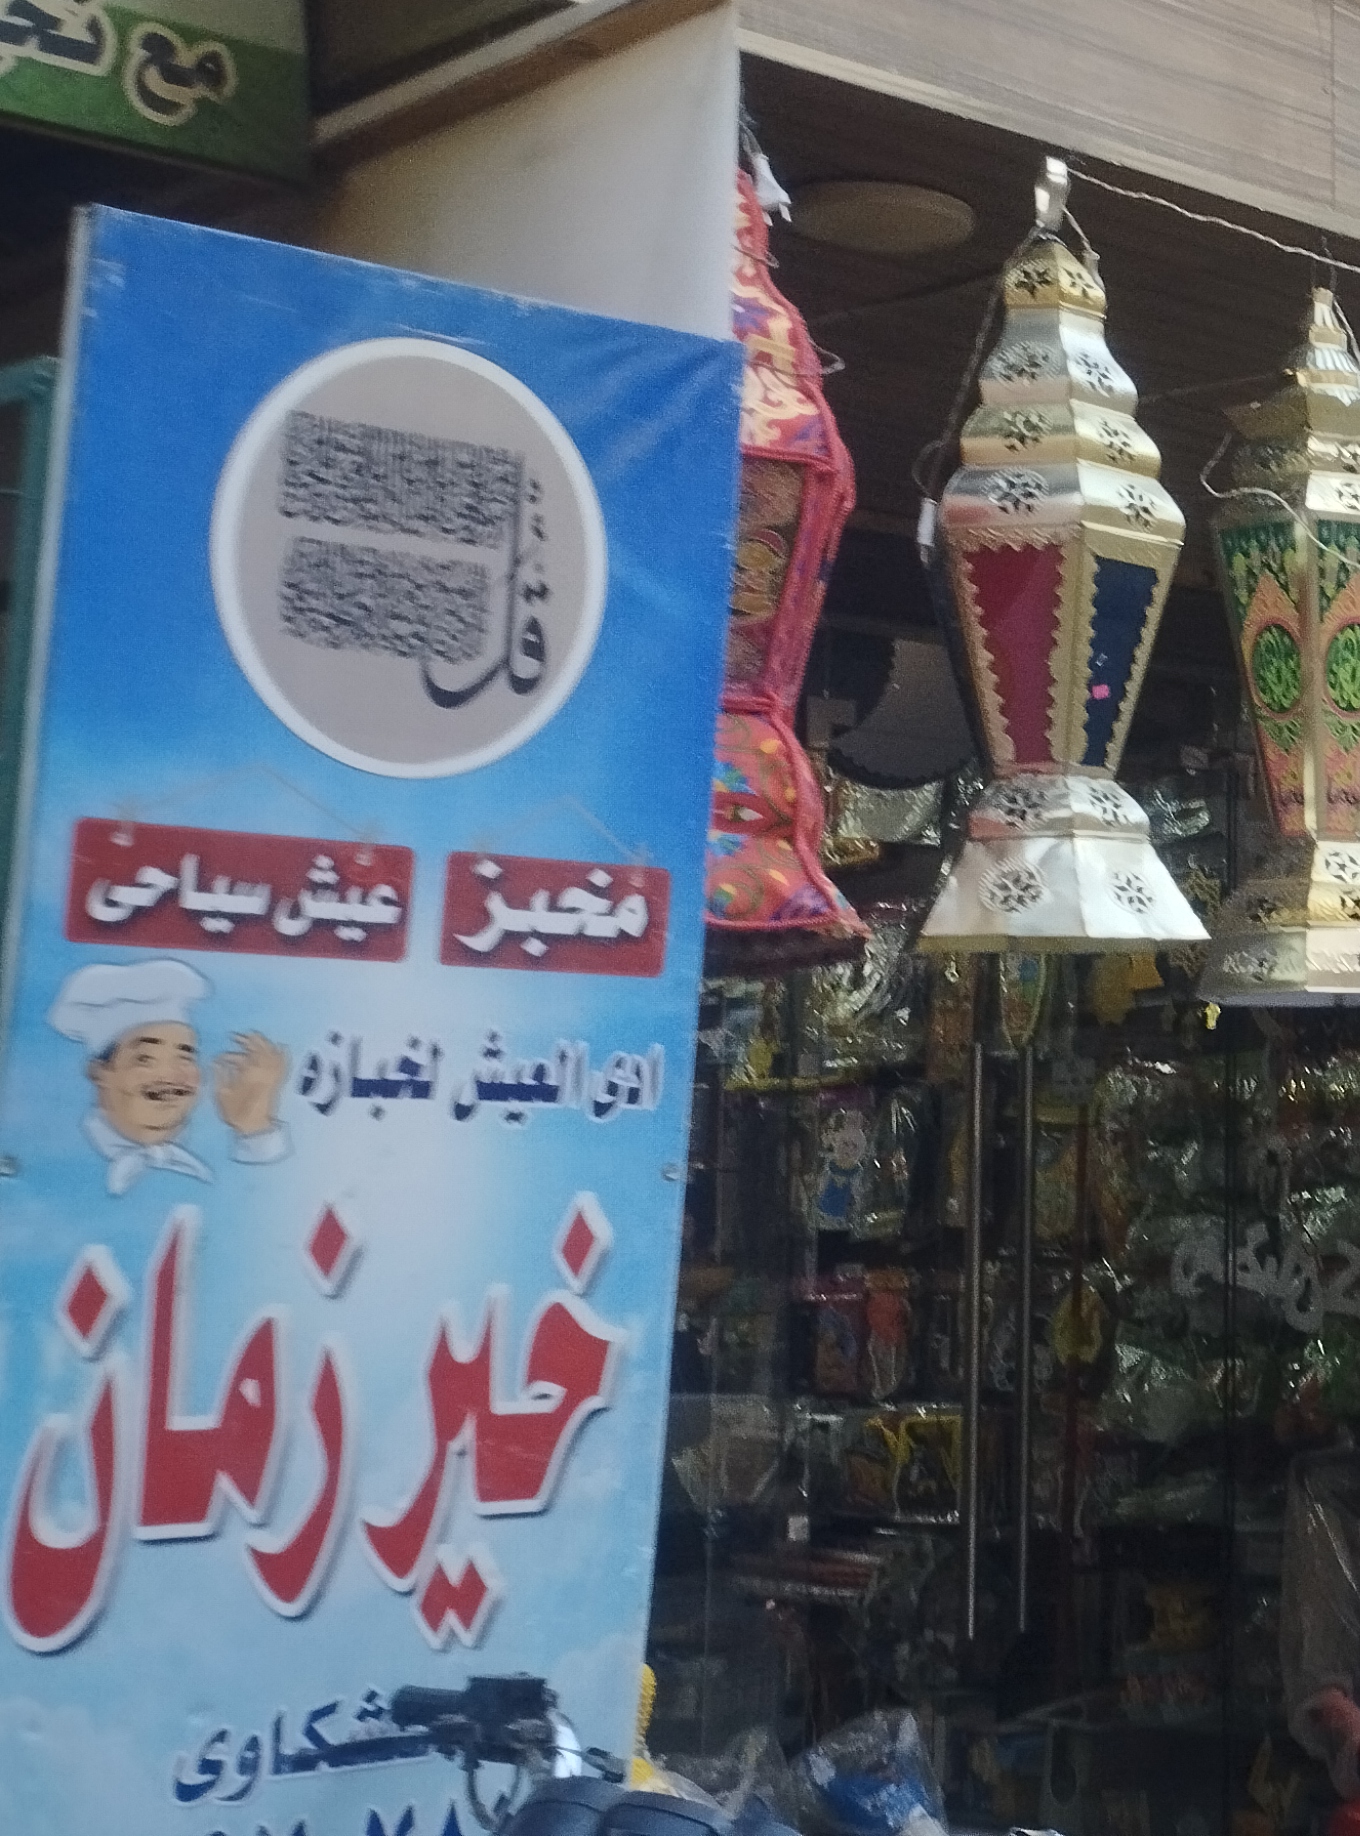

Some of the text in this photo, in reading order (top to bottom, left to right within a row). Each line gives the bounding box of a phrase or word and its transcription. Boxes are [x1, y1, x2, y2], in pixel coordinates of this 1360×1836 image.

[128, 25, 235, 124] مع
[273, 855, 403, 942] عيش
[453, 858, 650, 958] مخبز
[295, 1030, 445, 1120] لخبازه
[453, 1031, 590, 1127] العيش
[6, 1190, 627, 1653] خير زمان
